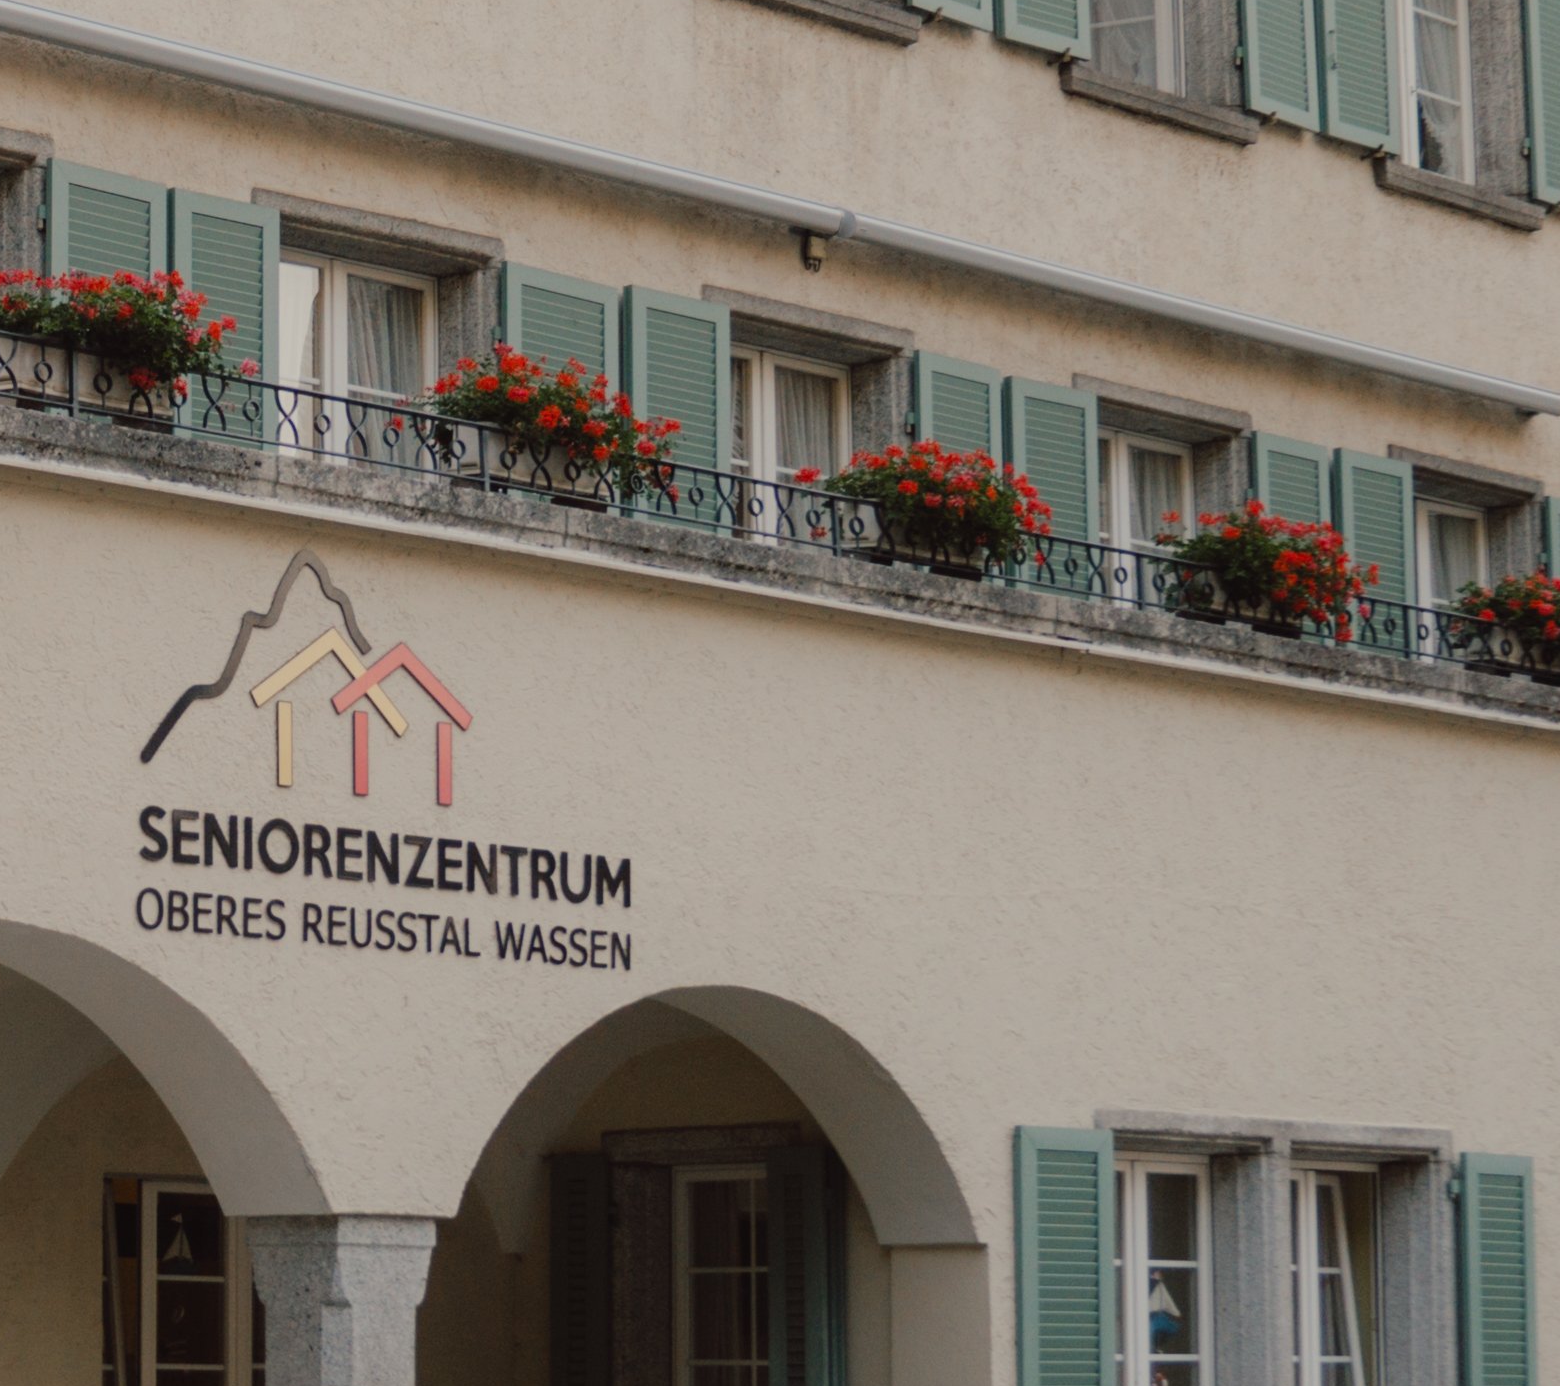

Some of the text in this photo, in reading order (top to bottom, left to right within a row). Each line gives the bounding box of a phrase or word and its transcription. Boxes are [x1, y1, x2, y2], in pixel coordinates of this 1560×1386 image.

[138, 805, 632, 908] SENIORENZENTRUM
[135, 887, 632, 971] OBERES REUSSTAL WASSEN
